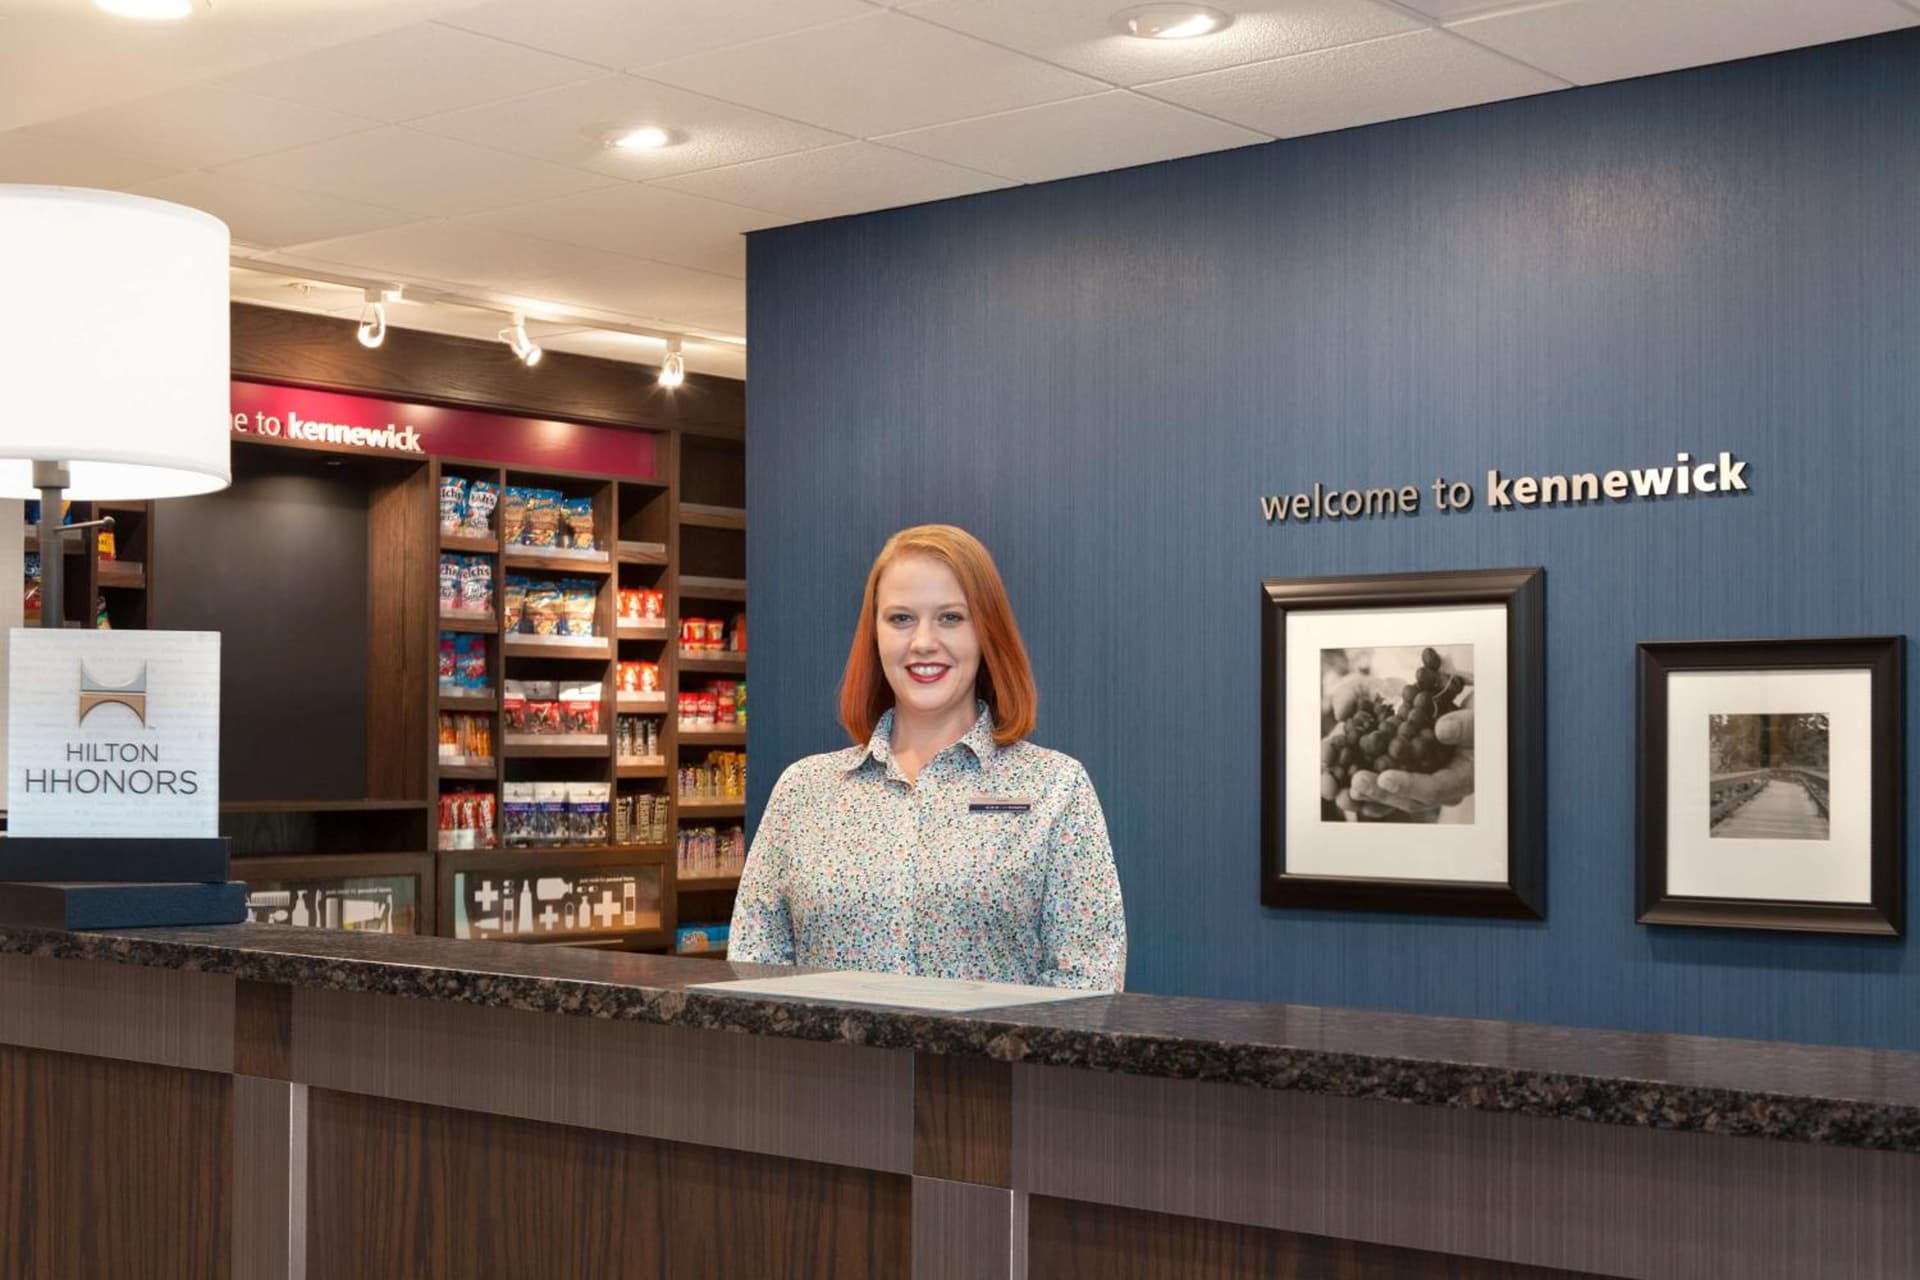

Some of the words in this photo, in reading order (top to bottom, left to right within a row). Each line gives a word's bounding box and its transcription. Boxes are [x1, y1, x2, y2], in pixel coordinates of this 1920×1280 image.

[256, 411, 281, 436] to
[288, 411, 422, 452] kennewick
[1260, 482, 1418, 521] welcome
[1432, 477, 1473, 510] to
[1487, 451, 1749, 507] kennewick
[66, 743, 159, 763] HILTON
[25, 769, 198, 795] HHONORS
